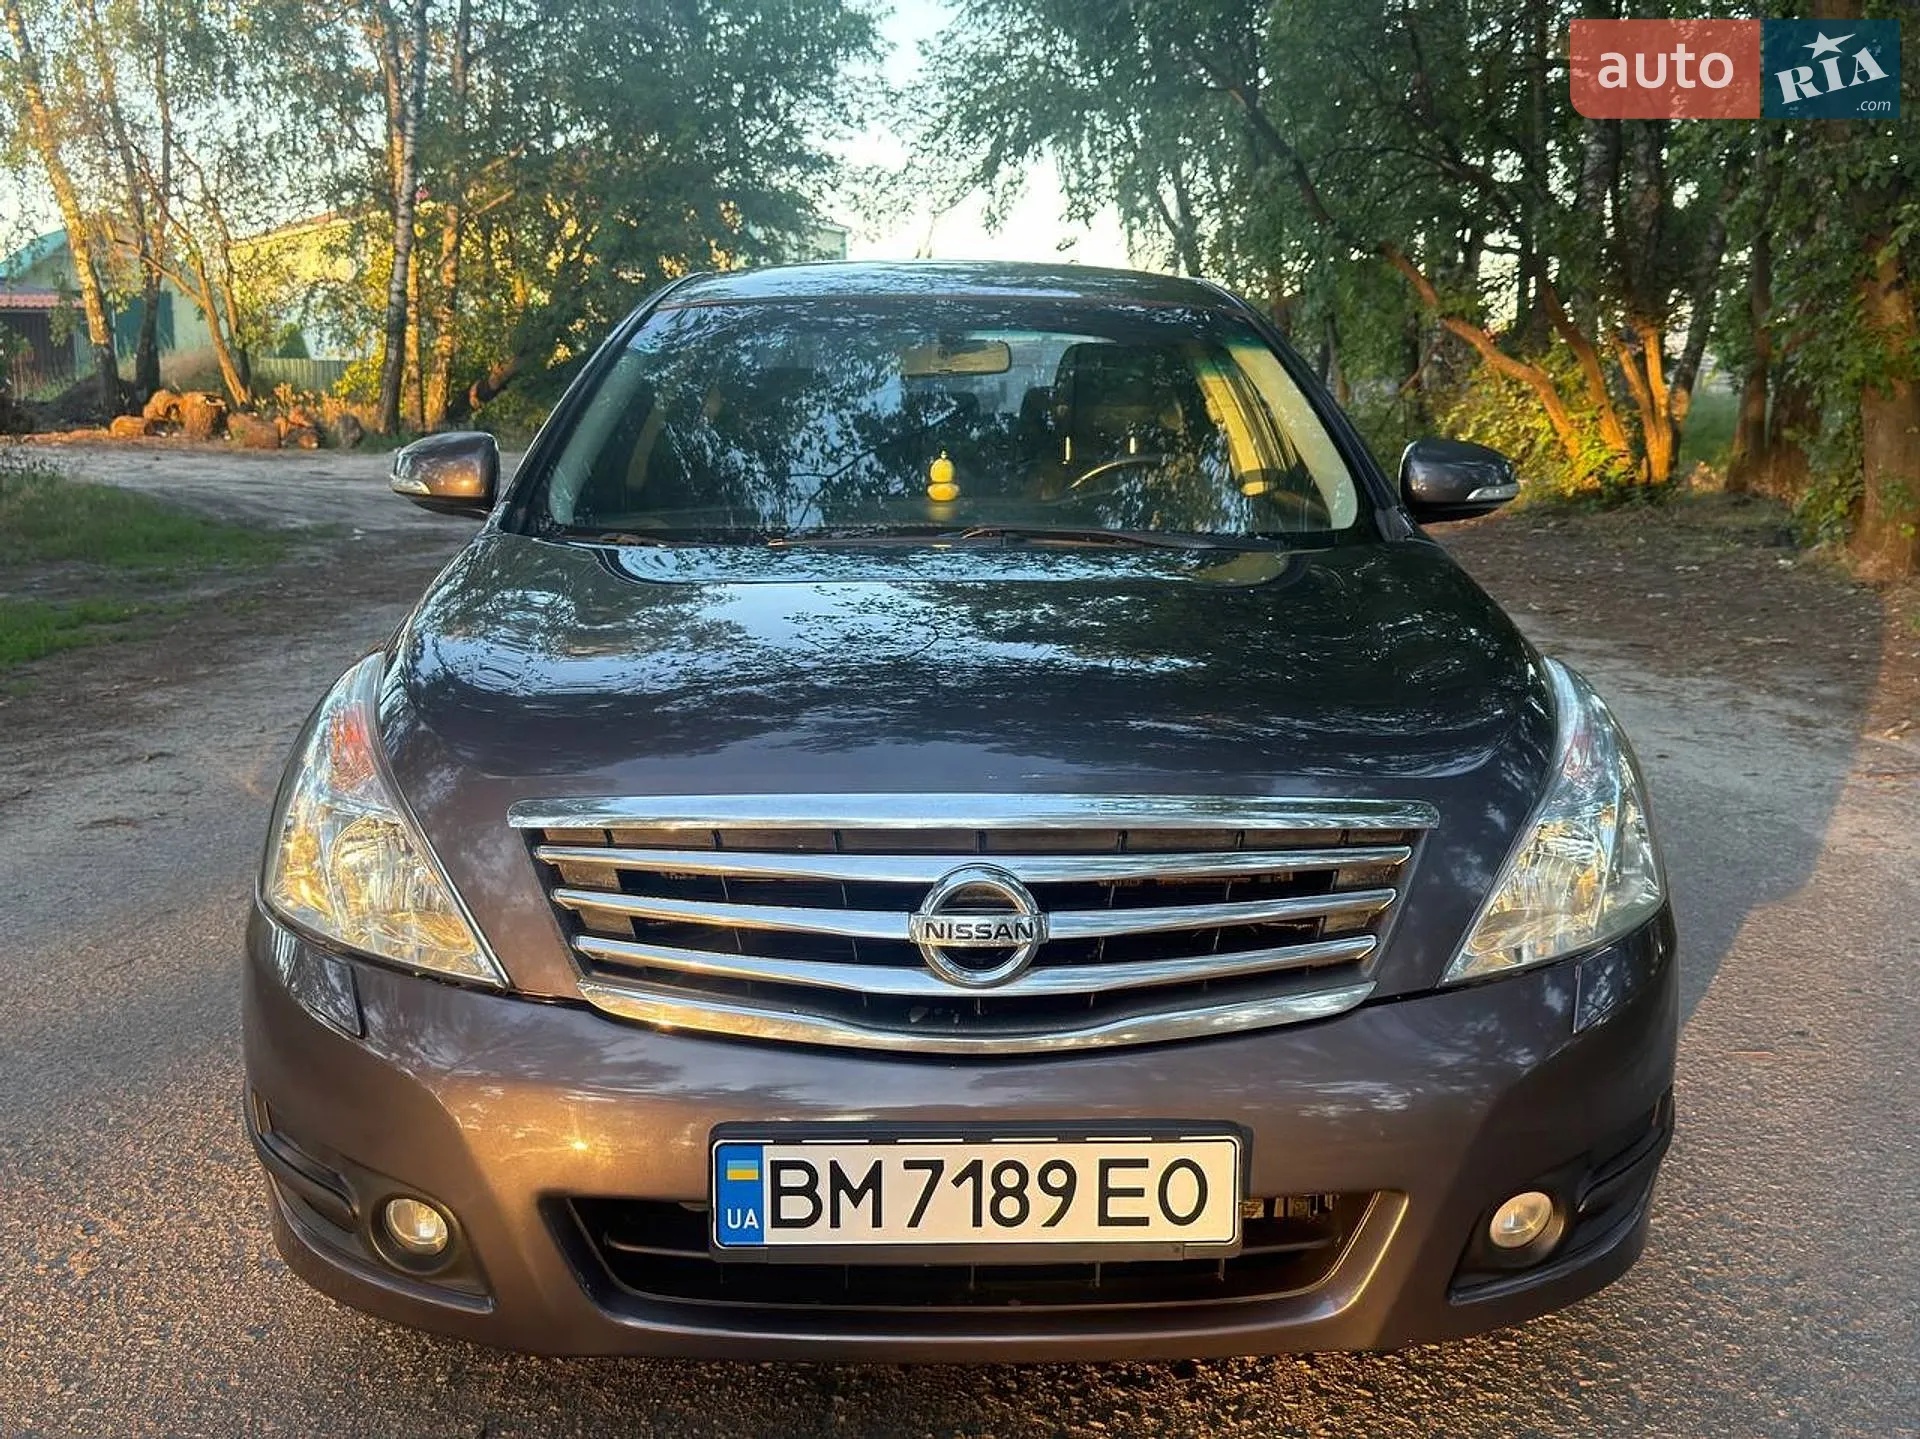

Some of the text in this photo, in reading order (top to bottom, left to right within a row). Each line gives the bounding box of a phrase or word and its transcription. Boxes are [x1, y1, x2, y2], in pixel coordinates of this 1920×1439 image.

[925, 922, 1034, 940] NISSAN
[769, 1157, 1208, 1229] BM 7189 EO
[726, 1208, 759, 1230] UA
